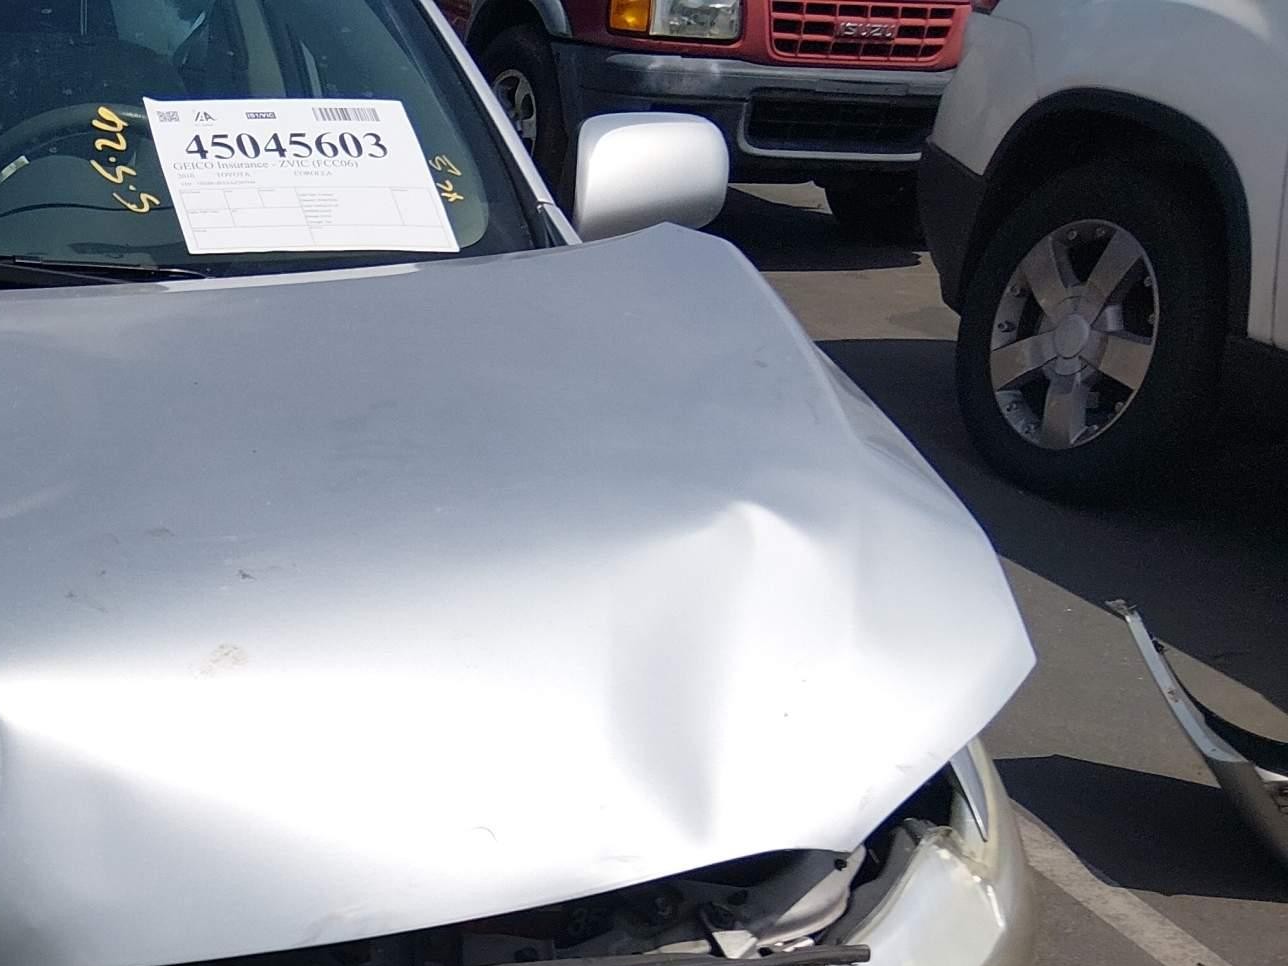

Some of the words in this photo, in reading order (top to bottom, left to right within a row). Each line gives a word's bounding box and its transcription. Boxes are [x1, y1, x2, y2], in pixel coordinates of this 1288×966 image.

[838, 22, 896, 37] ISUZU
[185, 131, 389, 160] 45045603
[173, 161, 214, 171] GEICO
[217, 160, 269, 169] Insurance
[279, 160, 311, 169] ZVIC
